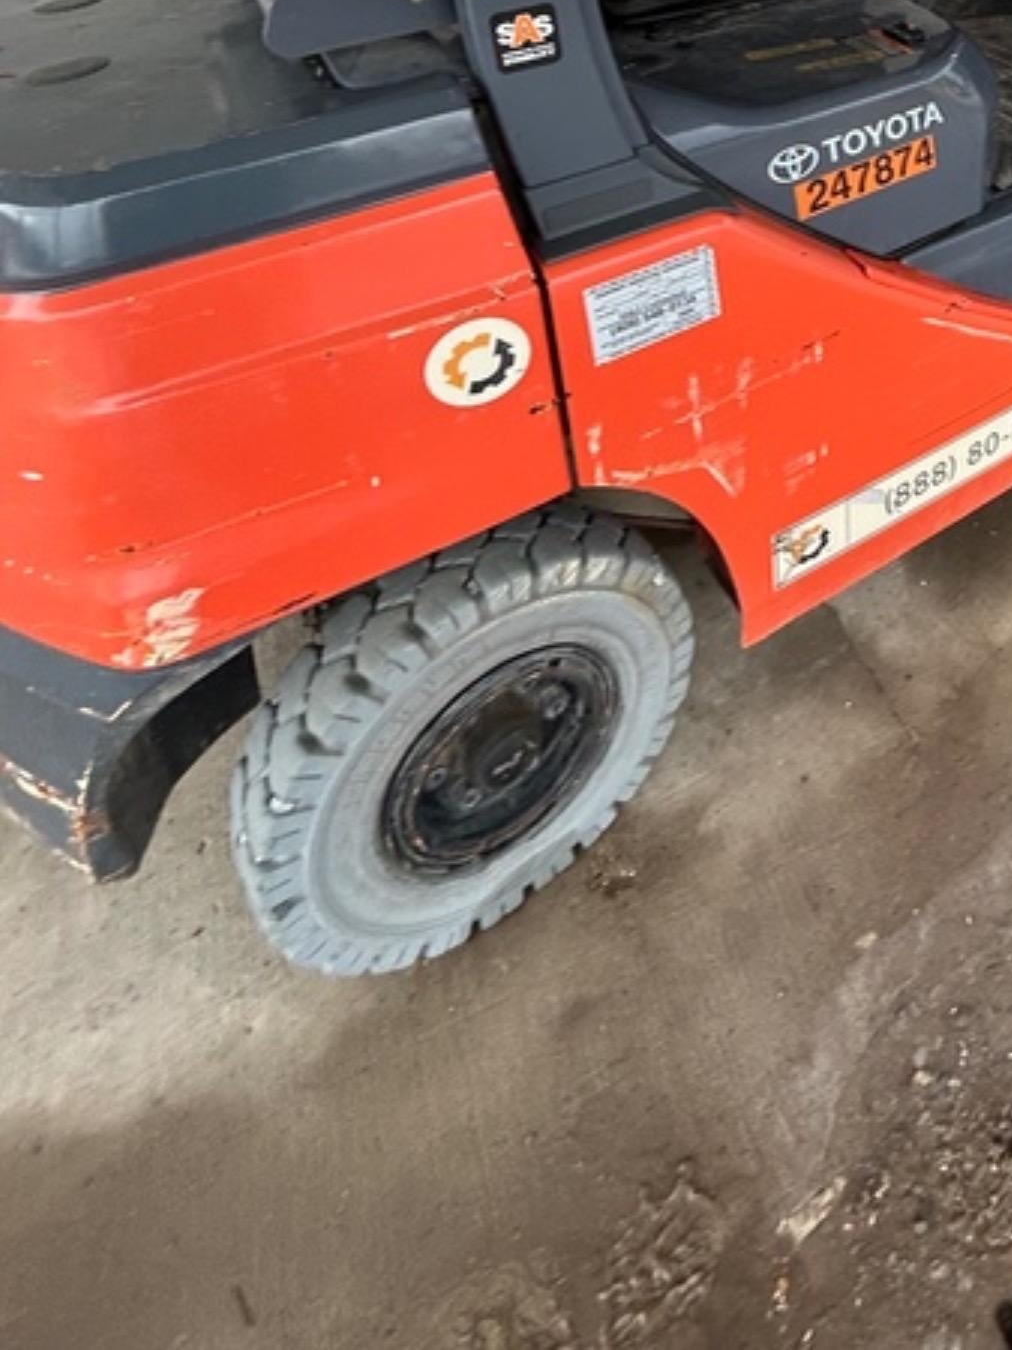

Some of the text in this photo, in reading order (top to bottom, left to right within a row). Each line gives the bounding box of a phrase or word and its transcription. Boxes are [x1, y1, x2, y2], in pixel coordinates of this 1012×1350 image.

[495, 12, 554, 48] SAS
[821, 101, 945, 163] TOYOTA
[806, 137, 935, 213] 247874
[884, 454, 958, 514] (888)
